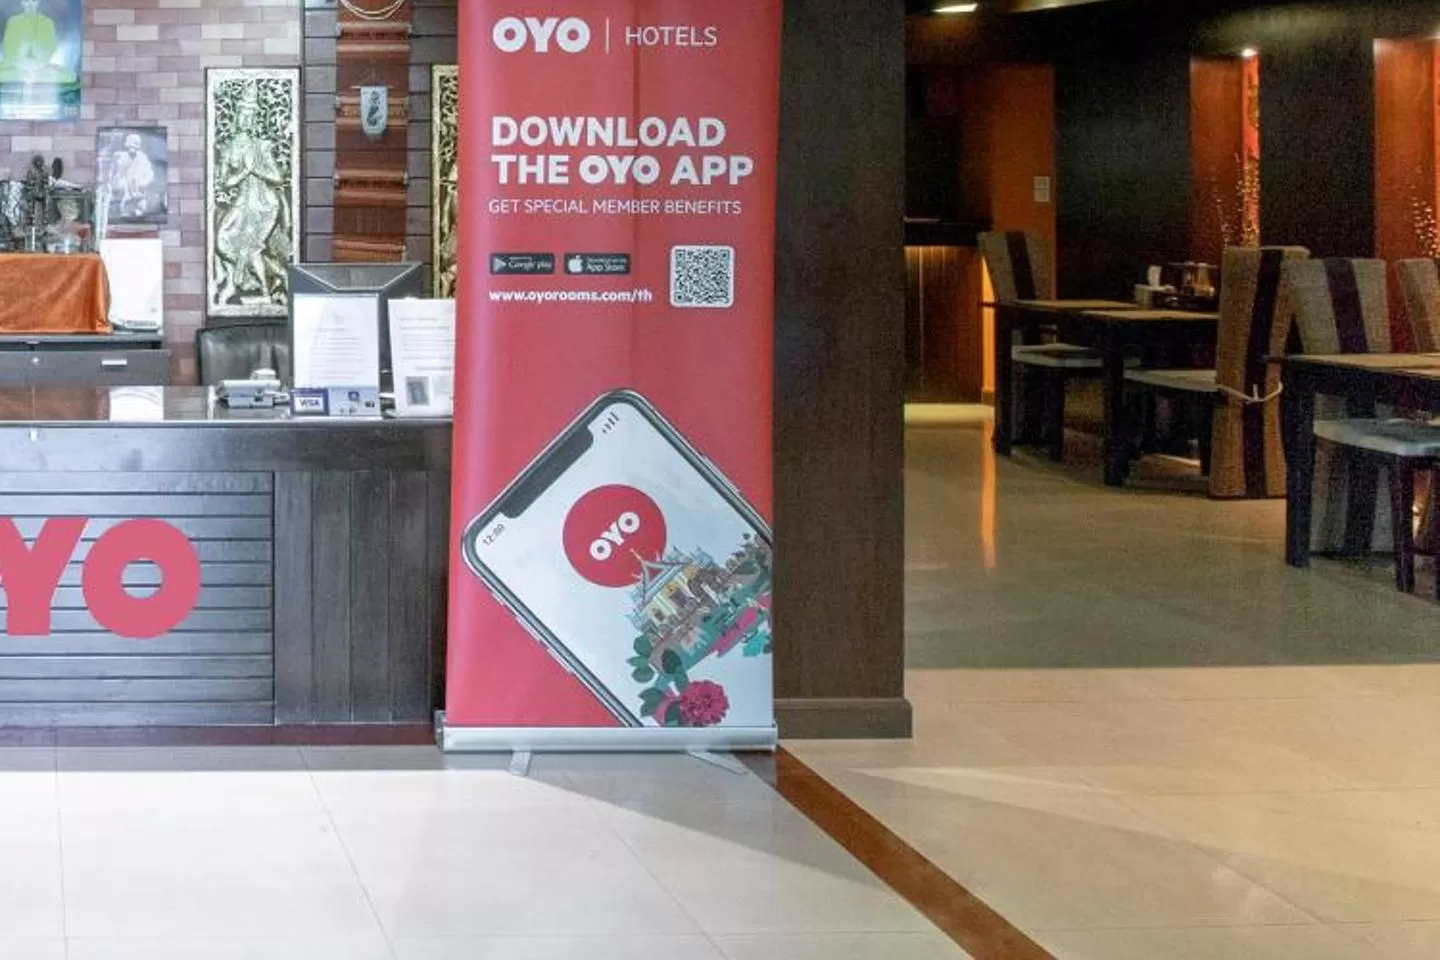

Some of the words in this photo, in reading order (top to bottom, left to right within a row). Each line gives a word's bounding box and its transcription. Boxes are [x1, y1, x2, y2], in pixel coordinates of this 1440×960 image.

[492, 16, 590, 53] OYO
[625, 26, 718, 47] HOTELS
[491, 116, 726, 147] DOWNLOAD
[491, 154, 569, 185] THE
[579, 154, 661, 185] OYO
[670, 155, 754, 185] APP
[489, 199, 518, 214] GET
[524, 200, 586, 214] SPECIAL
[593, 200, 660, 214] MEMBER
[664, 200, 742, 215] BENEFITS
[488, 289, 652, 304] www.oyorooms.com/th
[589, 511, 641, 561] OYO
